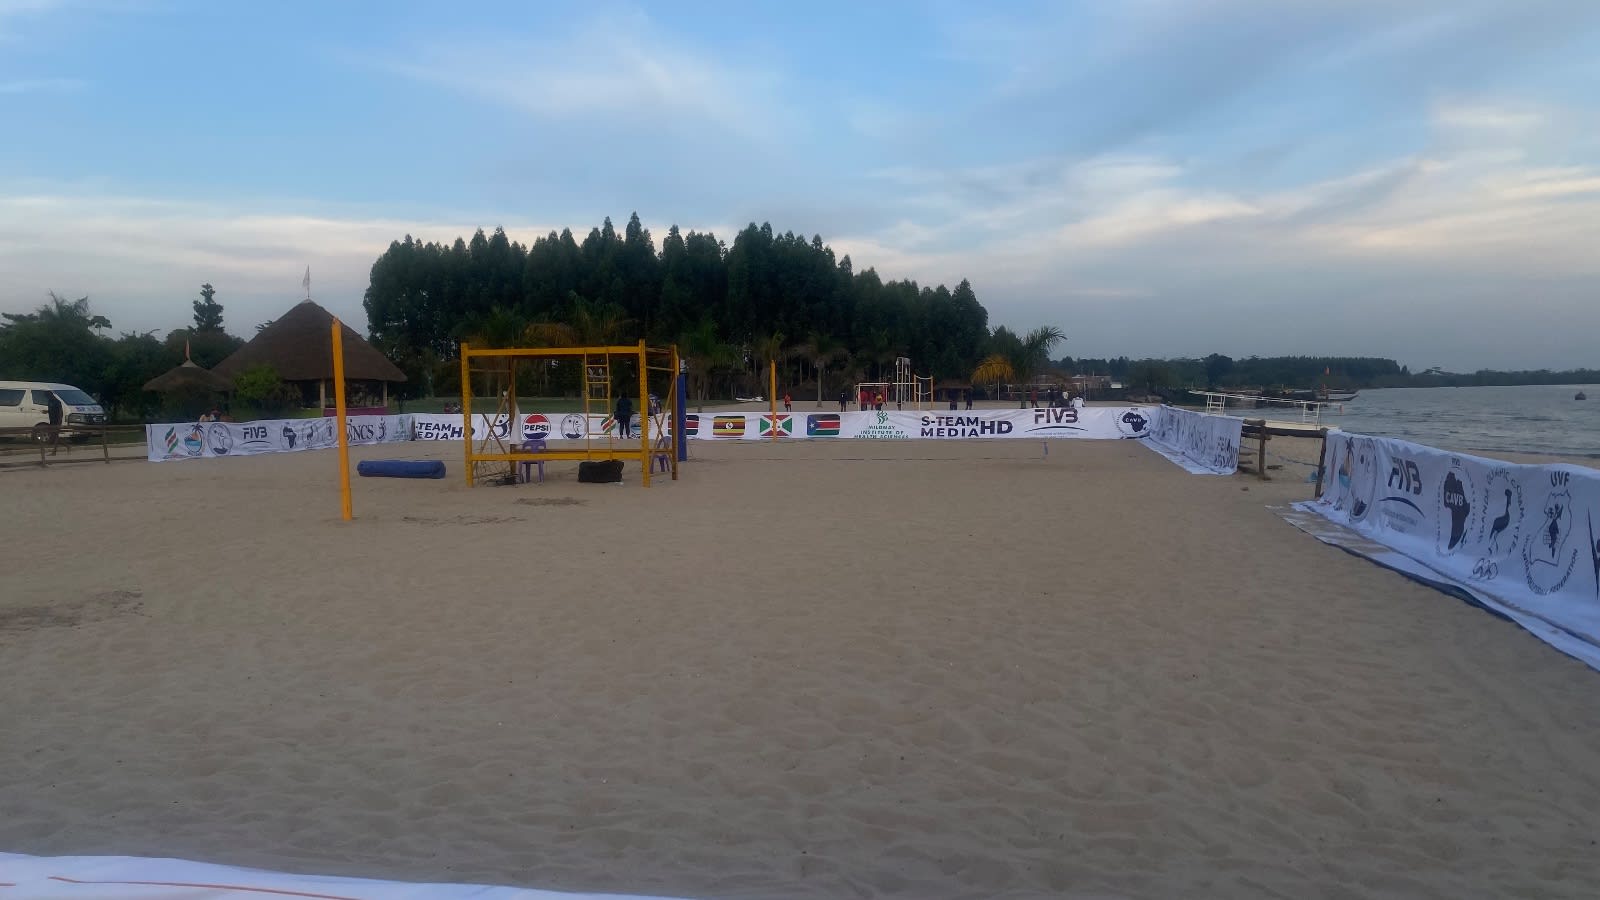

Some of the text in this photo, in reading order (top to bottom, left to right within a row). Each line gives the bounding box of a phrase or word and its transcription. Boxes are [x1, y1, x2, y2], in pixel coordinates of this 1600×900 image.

[921, 416, 979, 427] S-TEAM
[1034, 408, 1079, 424] FIVB
[242, 426, 268, 439] FIVB
[415, 422, 451, 431] -TEAM
[920, 427, 979, 437] MEDIA
[980, 420, 1013, 435] HD
[416, 431, 449, 440] EDIA
[1387, 456, 1423, 496] FIVB
[1550, 470, 1571, 488] UVF
[1445, 491, 1464, 507] CAVB
